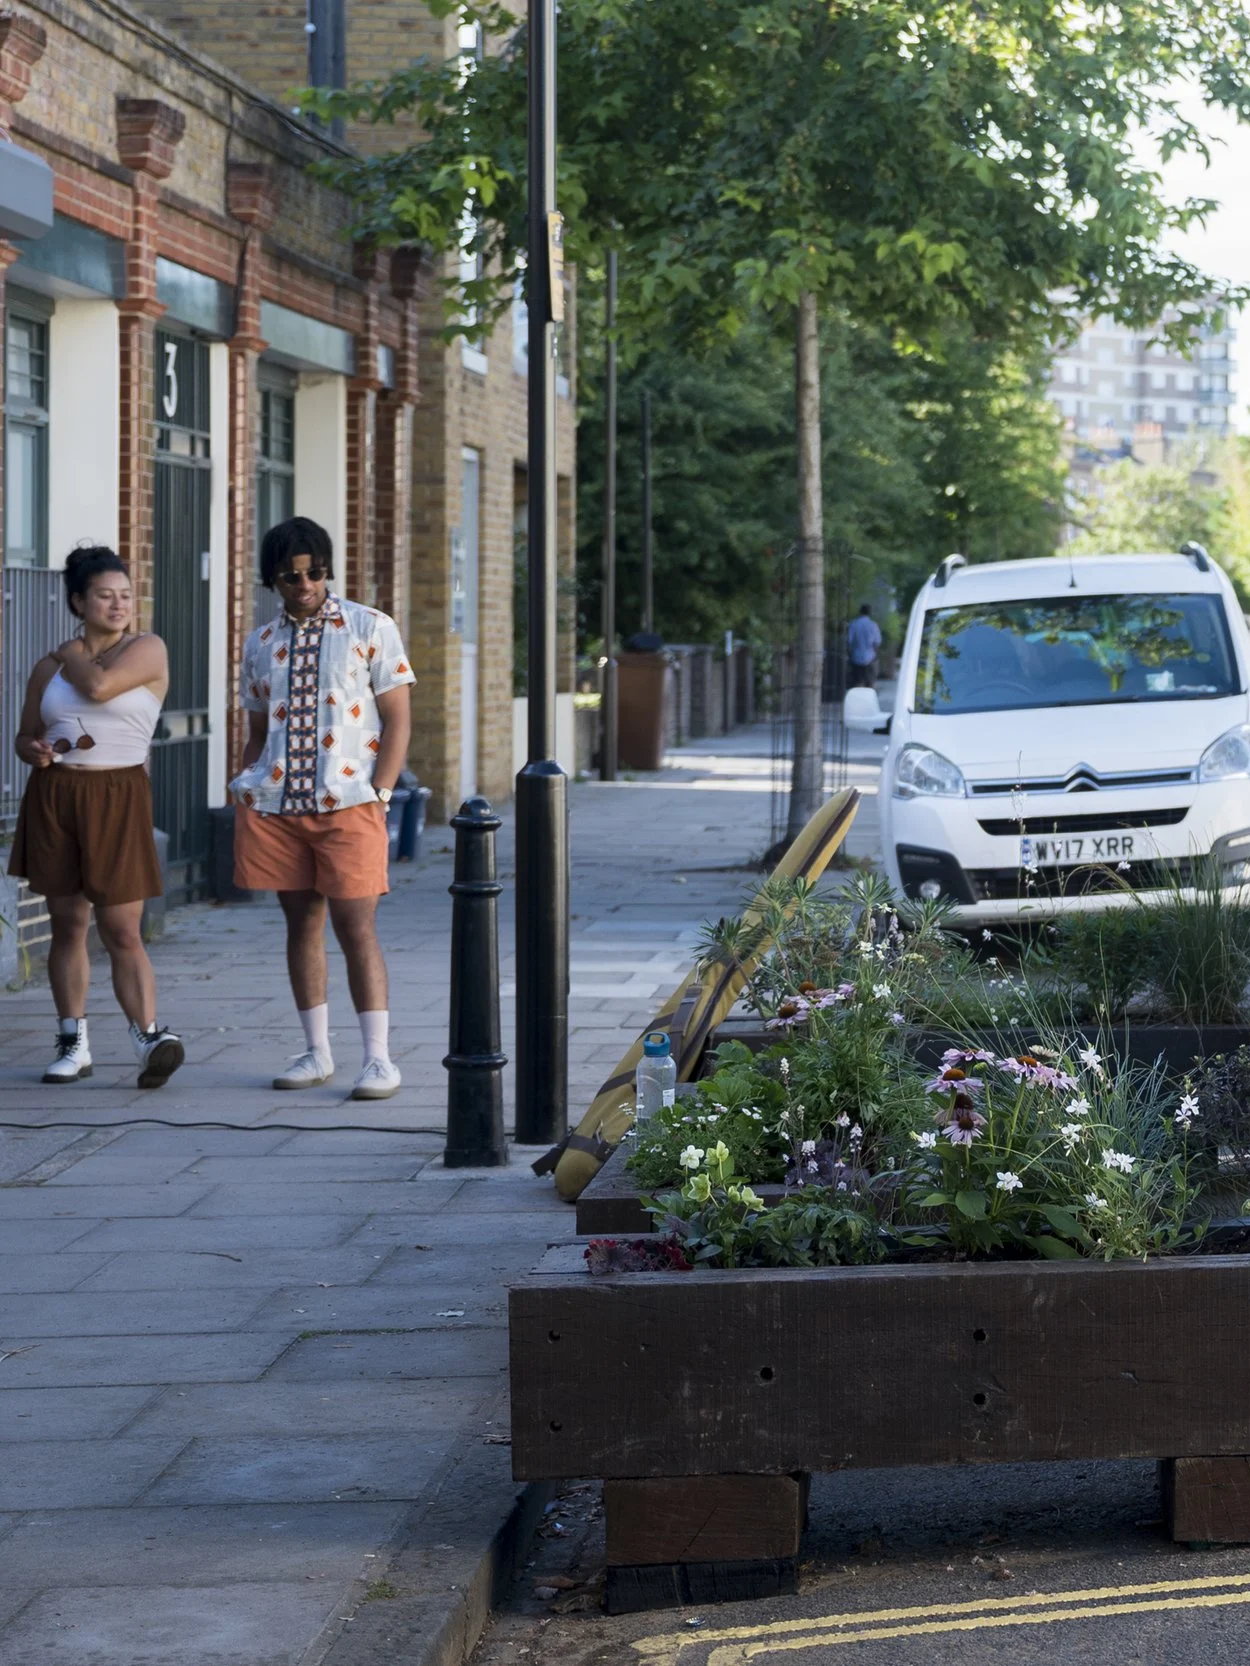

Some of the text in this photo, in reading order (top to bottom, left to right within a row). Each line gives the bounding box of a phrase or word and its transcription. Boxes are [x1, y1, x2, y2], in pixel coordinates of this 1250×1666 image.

[163, 342, 178, 418] 3
[1035, 836, 1134, 861] WV17 XRR
